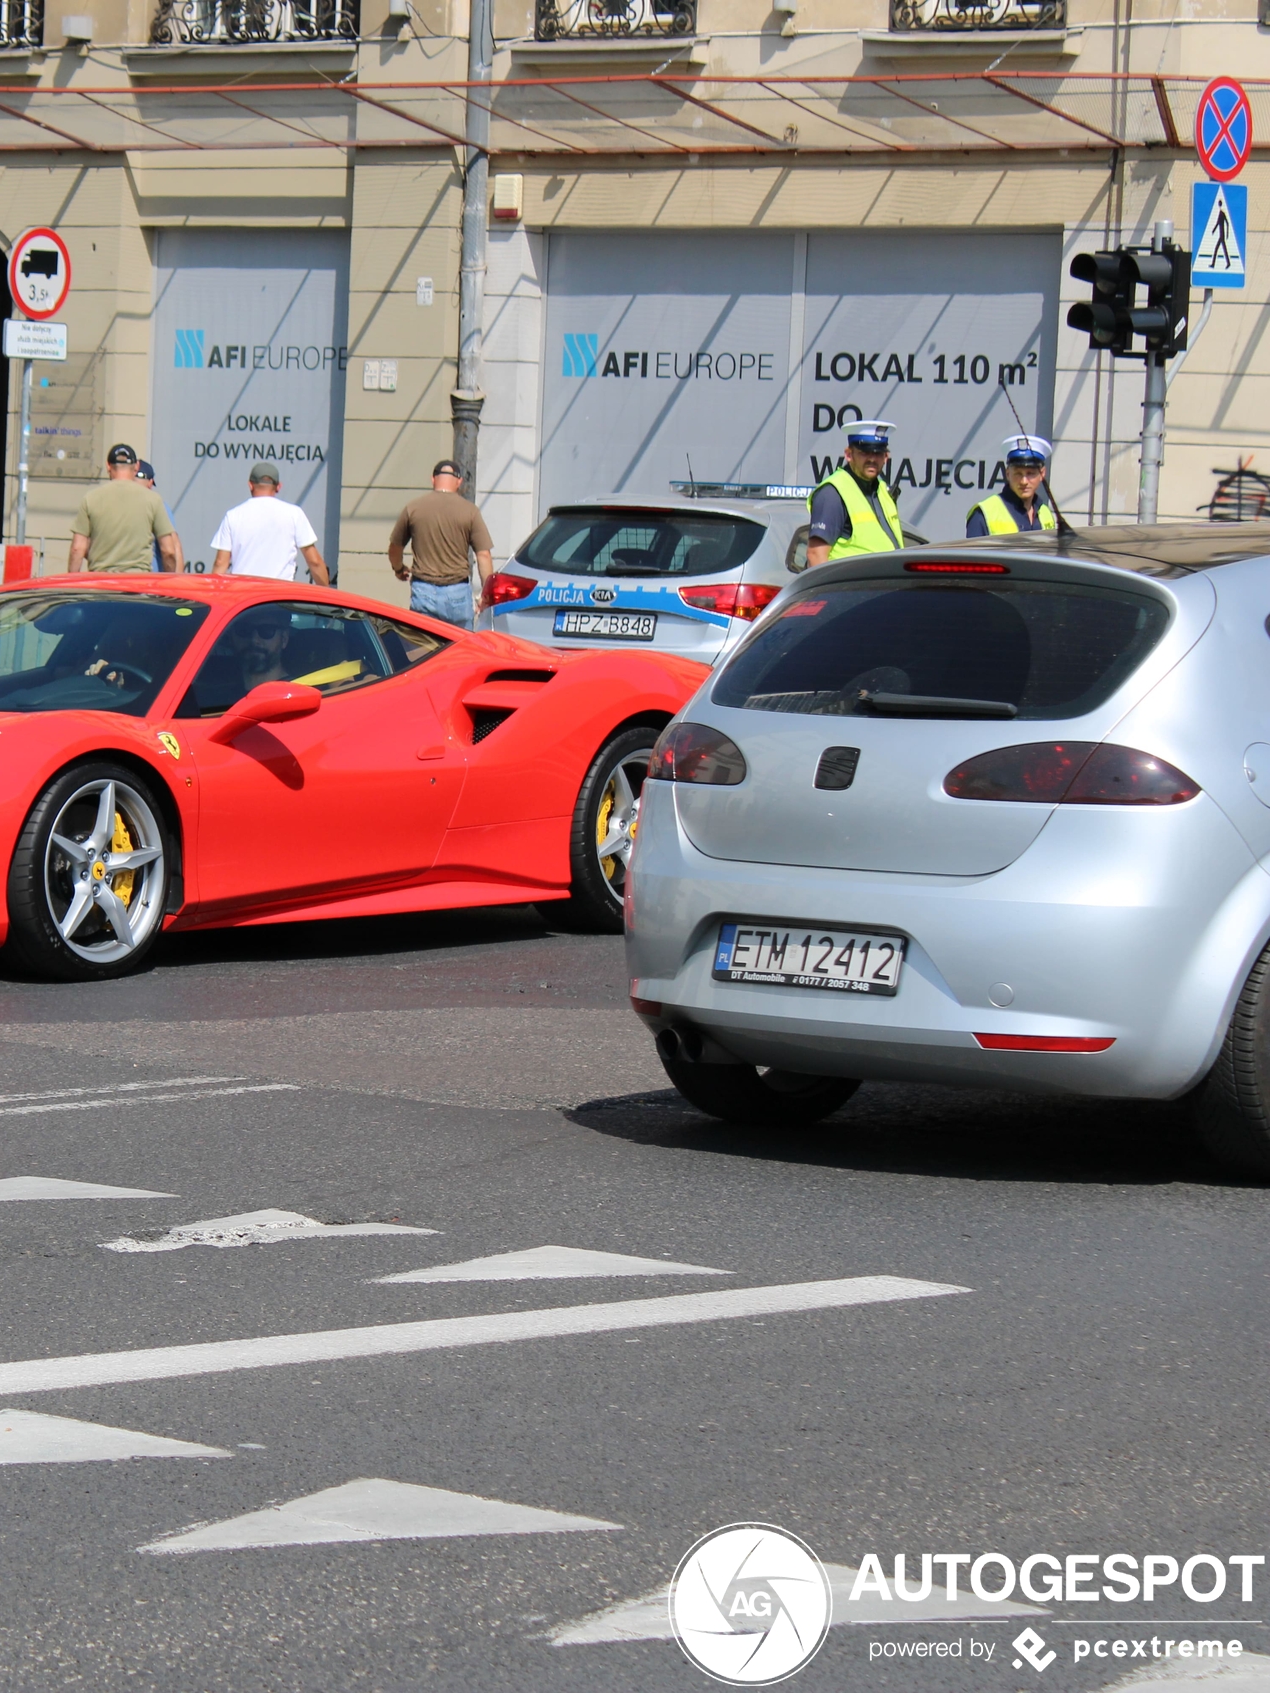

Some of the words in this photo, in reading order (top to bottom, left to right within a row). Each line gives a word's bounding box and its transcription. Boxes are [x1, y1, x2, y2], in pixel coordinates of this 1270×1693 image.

[207, 345, 246, 368] AFI
[252, 345, 347, 371] EUROPE
[602, 352, 648, 378] AFI
[655, 352, 775, 381] EUROPE
[814, 352, 923, 383] LOKAL
[933, 354, 990, 385] 110
[227, 414, 292, 433] LOKALE
[194, 442, 220, 459] DO
[223, 443, 325, 464] WYNAJĘCIA
[537, 588, 585, 604] POLICJA
[594, 591, 612, 601] KIA
[566, 613, 604, 633] HPZ
[609, 616, 652, 636] B848
[718, 953, 728, 963] PL
[731, 930, 790, 970] ETM
[800, 934, 896, 981] 12412
[731, 971, 743, 981] DT
[743, 971, 786, 983] Automobile
[799, 975, 821, 986] 0177
[828, 979, 851, 989] 2057
[851, 981, 870, 992] 348
